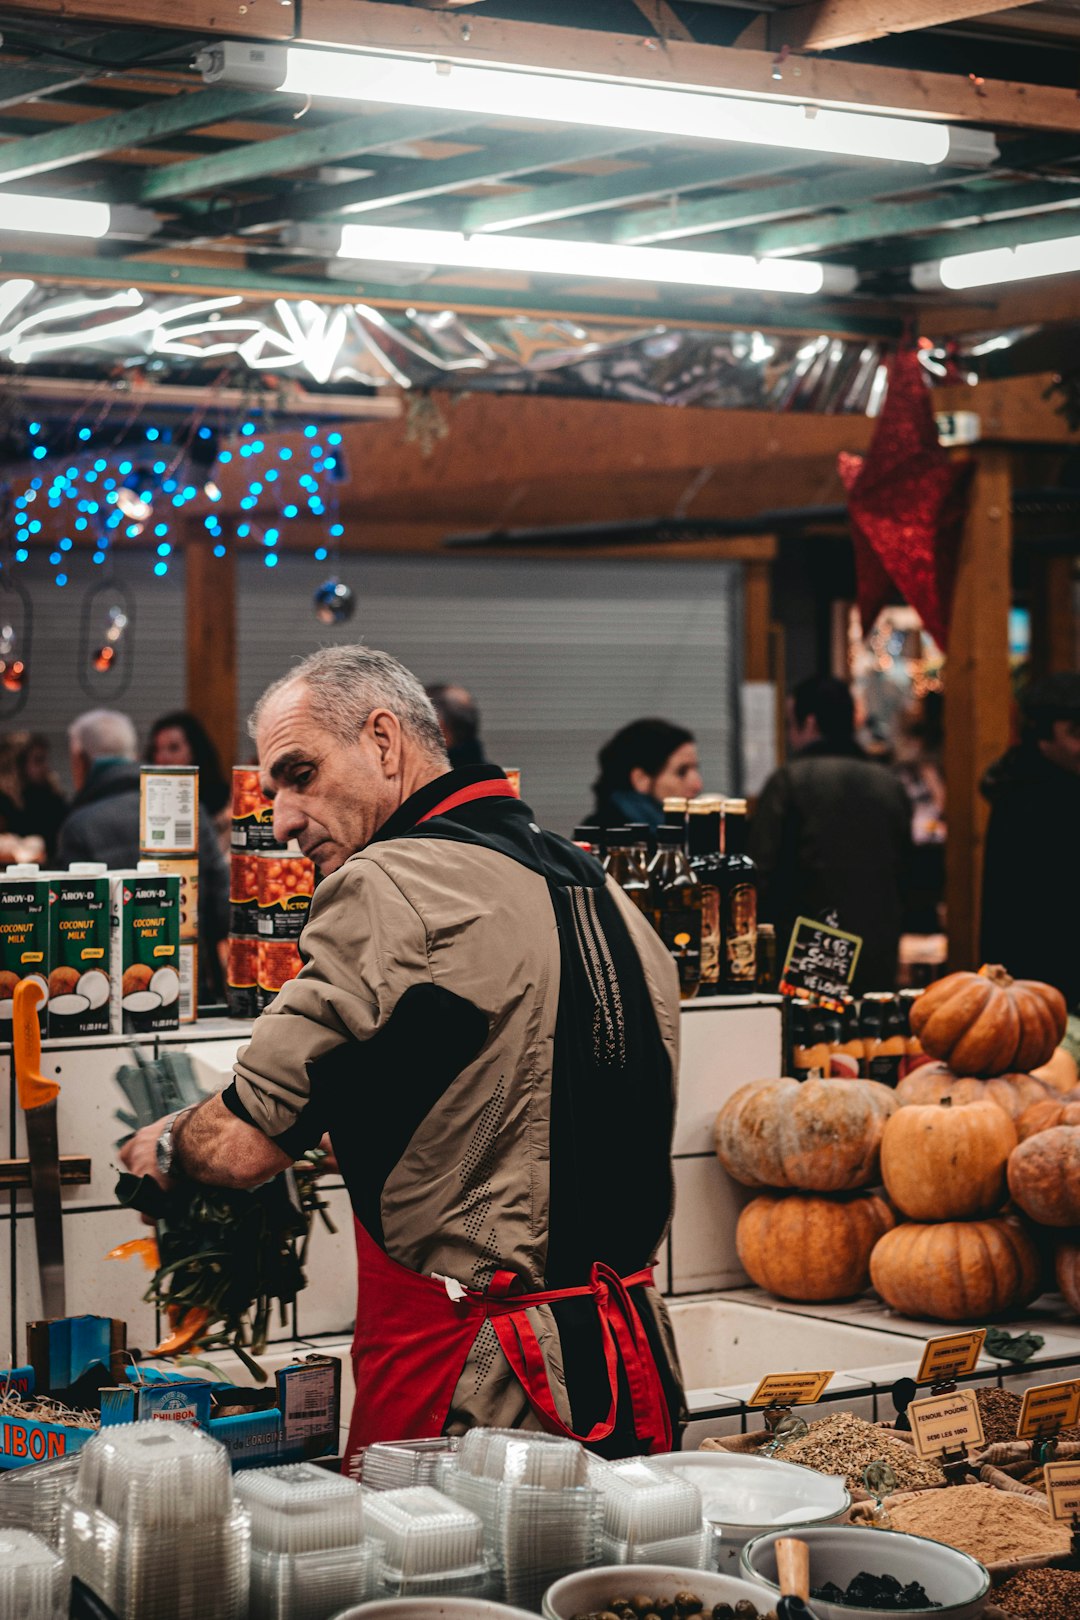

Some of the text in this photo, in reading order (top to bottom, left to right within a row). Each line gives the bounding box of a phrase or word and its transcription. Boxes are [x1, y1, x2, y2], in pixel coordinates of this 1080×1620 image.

[2, 894, 35, 903] AROY-D
[61, 891, 95, 901] AROY-D
[135, 889, 166, 899] AROY-D
[59, 920, 94, 930] COCONUT
[133, 917, 165, 928] COCONUT
[0, 923, 34, 933] COCONUT
[67, 931, 86, 941] MILK
[141, 929, 158, 938] MILK
[7, 934, 26, 944] MILK
[918, 1405, 968, 1422] FENOUIL POUDRE
[941, 1430, 952, 1438] LES
[0, 1423, 66, 1461] IBON
